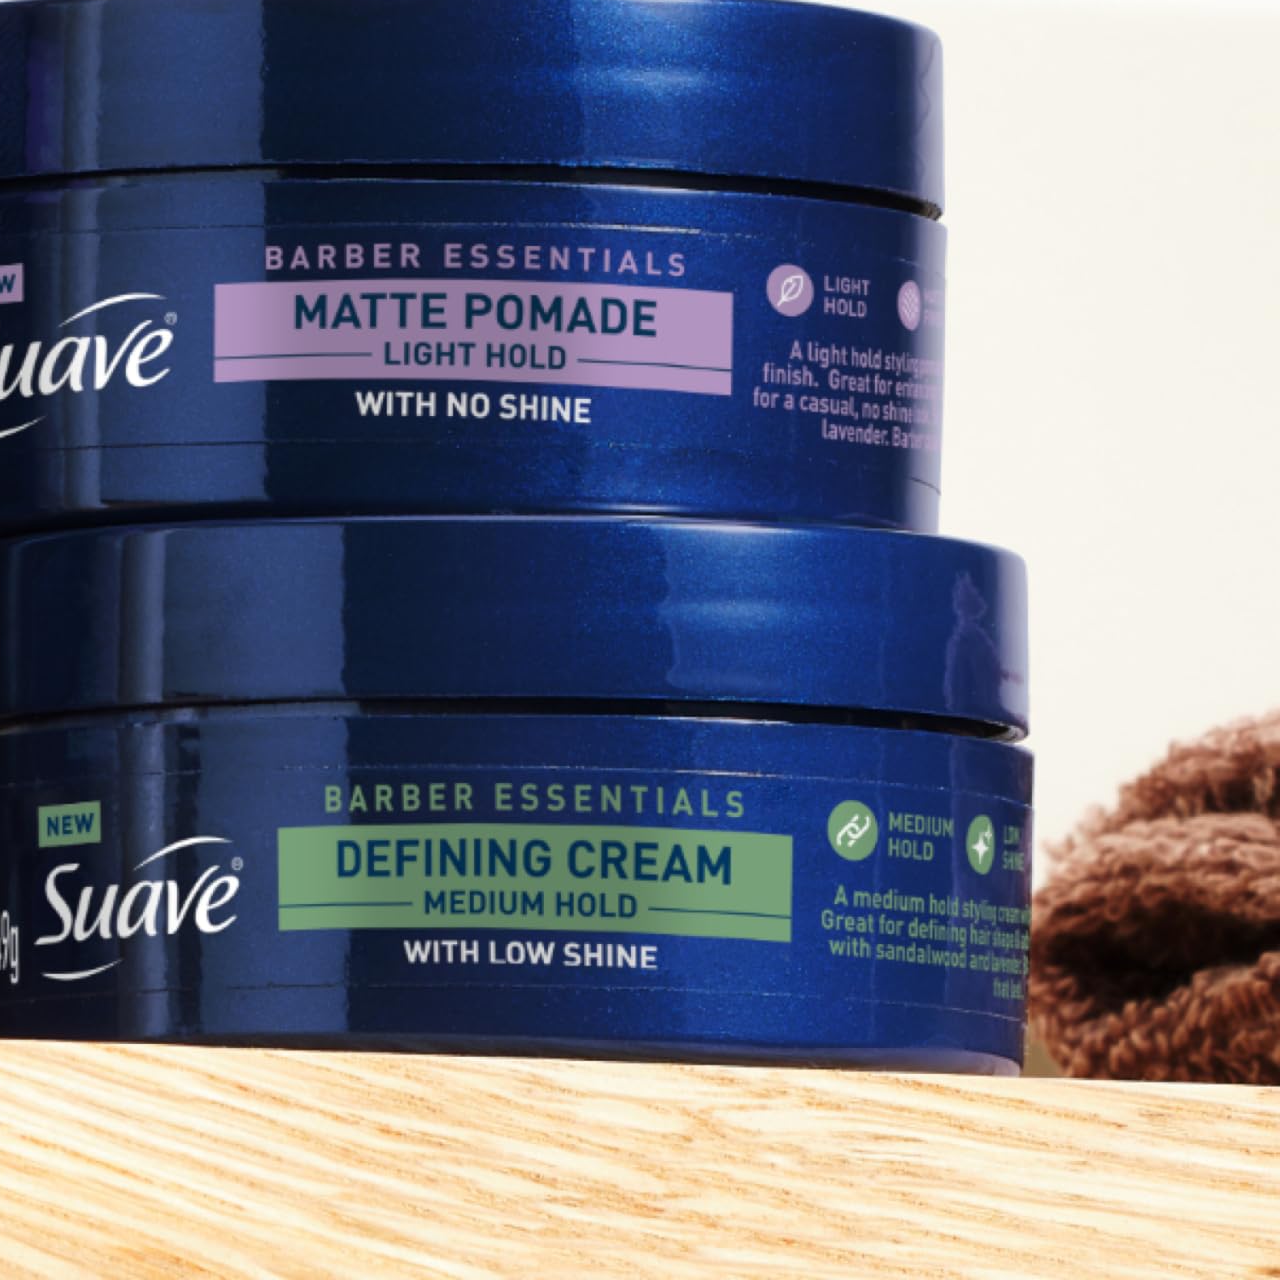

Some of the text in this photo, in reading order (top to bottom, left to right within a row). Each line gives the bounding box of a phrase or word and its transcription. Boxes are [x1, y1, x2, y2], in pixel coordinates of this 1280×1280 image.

[265, 242, 686, 277] BARBER ESSENTIALS
[823, 275, 871, 296] LIGHT
[294, 292, 657, 338] MATTE POMADE
[823, 298, 867, 318] HOLD
[383, 341, 566, 370] LIGHT HOLD
[789, 339, 803, 360] A
[807, 341, 848, 369] light
[851, 346, 882, 370] hold
[763, 363, 819, 387] finish.
[828, 370, 870, 392] Great
[874, 373, 893, 395] for
[355, 390, 591, 424] WITH NO SHINE
[753, 387, 779, 407] for
[784, 394, 794, 410] a
[800, 395, 859, 419] casual,
[862, 402, 880, 419] no
[325, 783, 745, 818] BARBER ESSENTIALS
[47, 813, 94, 836] NEW
[889, 812, 954, 837] MEDIUM
[337, 838, 732, 886] DEFINING CREAM
[888, 838, 934, 861] HOLD
[424, 890, 637, 918] MEDIUM HOLD
[834, 884, 848, 906] A
[853, 888, 925, 913] medium
[929, 893, 959, 917] hold
[821, 909, 874, 933] Great
[878, 914, 902, 937] for
[907, 917, 967, 947] defining
[403, 939, 658, 970] WITH LOW SHINE
[828, 936, 871, 958] with
[876, 942, 967, 968] sandalwood
